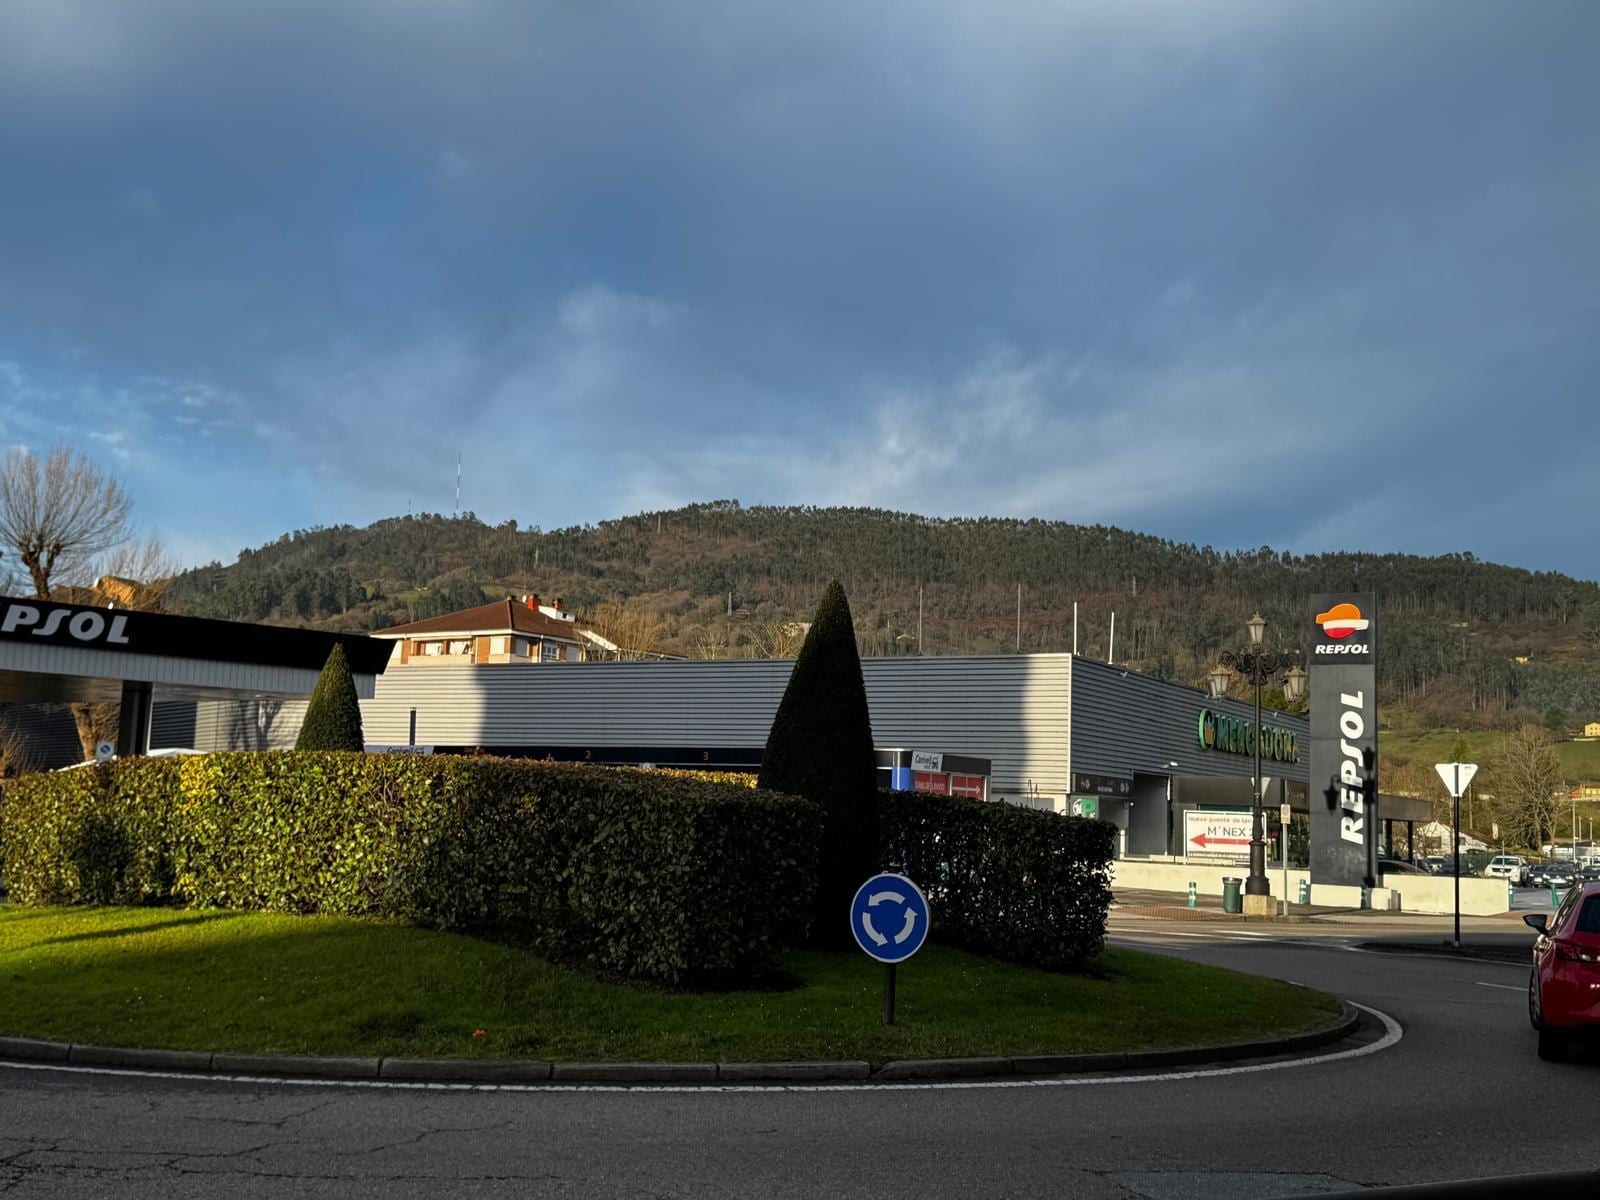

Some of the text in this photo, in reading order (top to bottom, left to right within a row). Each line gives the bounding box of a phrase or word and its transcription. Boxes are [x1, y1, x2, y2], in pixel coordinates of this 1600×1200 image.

[1, 604, 130, 644] PSOL
[1315, 644, 1369, 654] REPSOL
[1340, 690, 1364, 845] REPSOL
